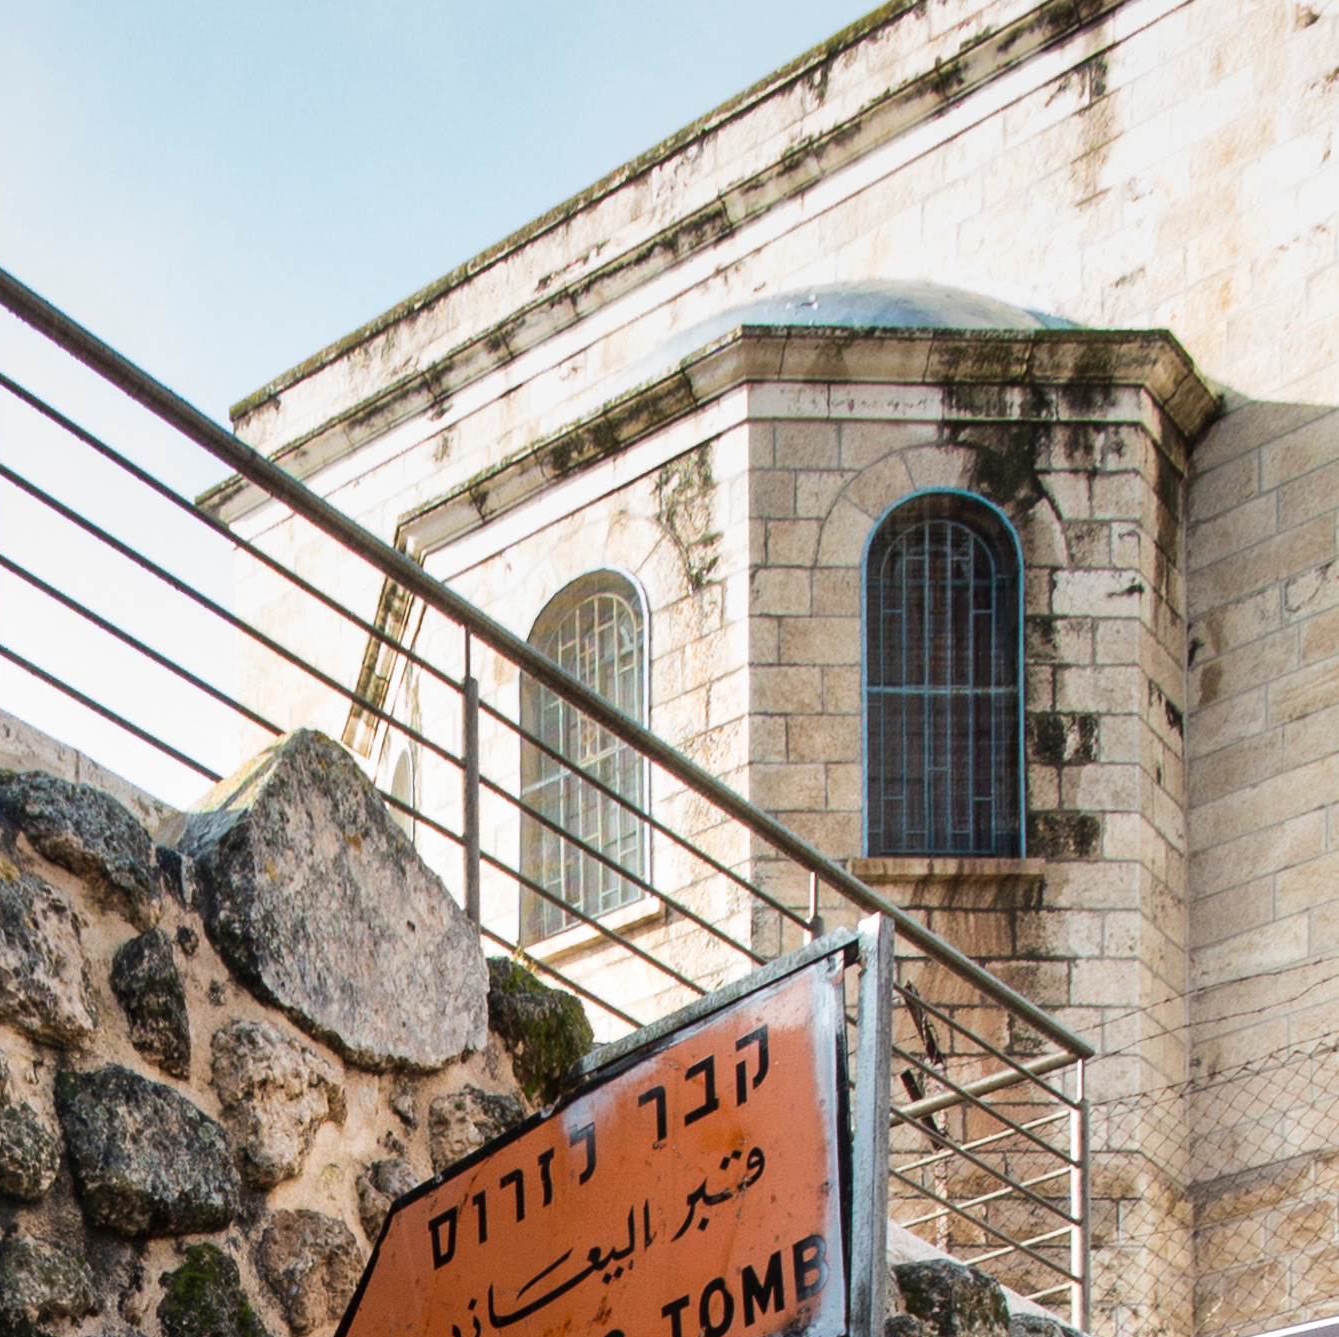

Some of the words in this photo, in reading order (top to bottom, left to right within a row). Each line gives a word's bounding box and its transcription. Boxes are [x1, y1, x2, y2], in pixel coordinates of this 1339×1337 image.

[638, 1024, 769, 1142] קבר
[428, 1121, 597, 1270] לזרוס
[671, 1147, 765, 1242] قبر
